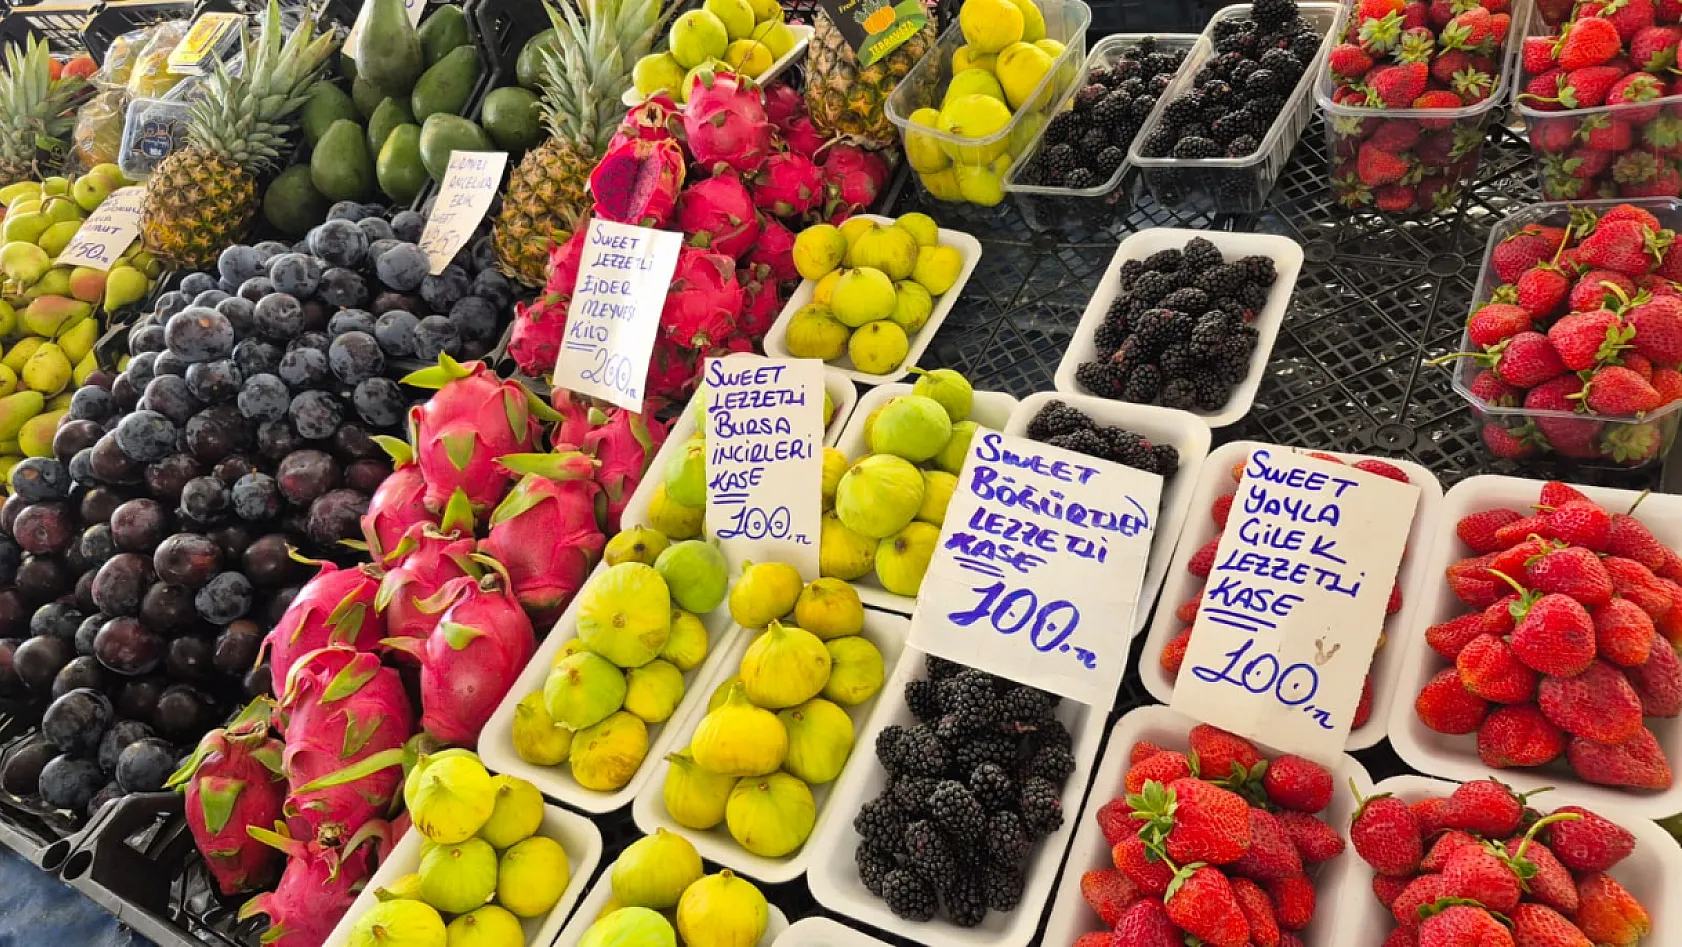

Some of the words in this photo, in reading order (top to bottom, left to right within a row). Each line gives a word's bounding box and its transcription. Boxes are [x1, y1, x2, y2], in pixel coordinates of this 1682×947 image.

[592, 223, 640, 250] SWEET
[706, 359, 786, 387] SWEET
[713, 410, 791, 438] BURSA
[709, 467, 765, 492] KASE
[976, 434, 1100, 485] SWEET
[1246, 450, 1359, 498] SWEET
[1244, 484, 1340, 527] YAYLA
[945, 532, 1047, 574] KASE
[1208, 576, 1304, 616] KASE
